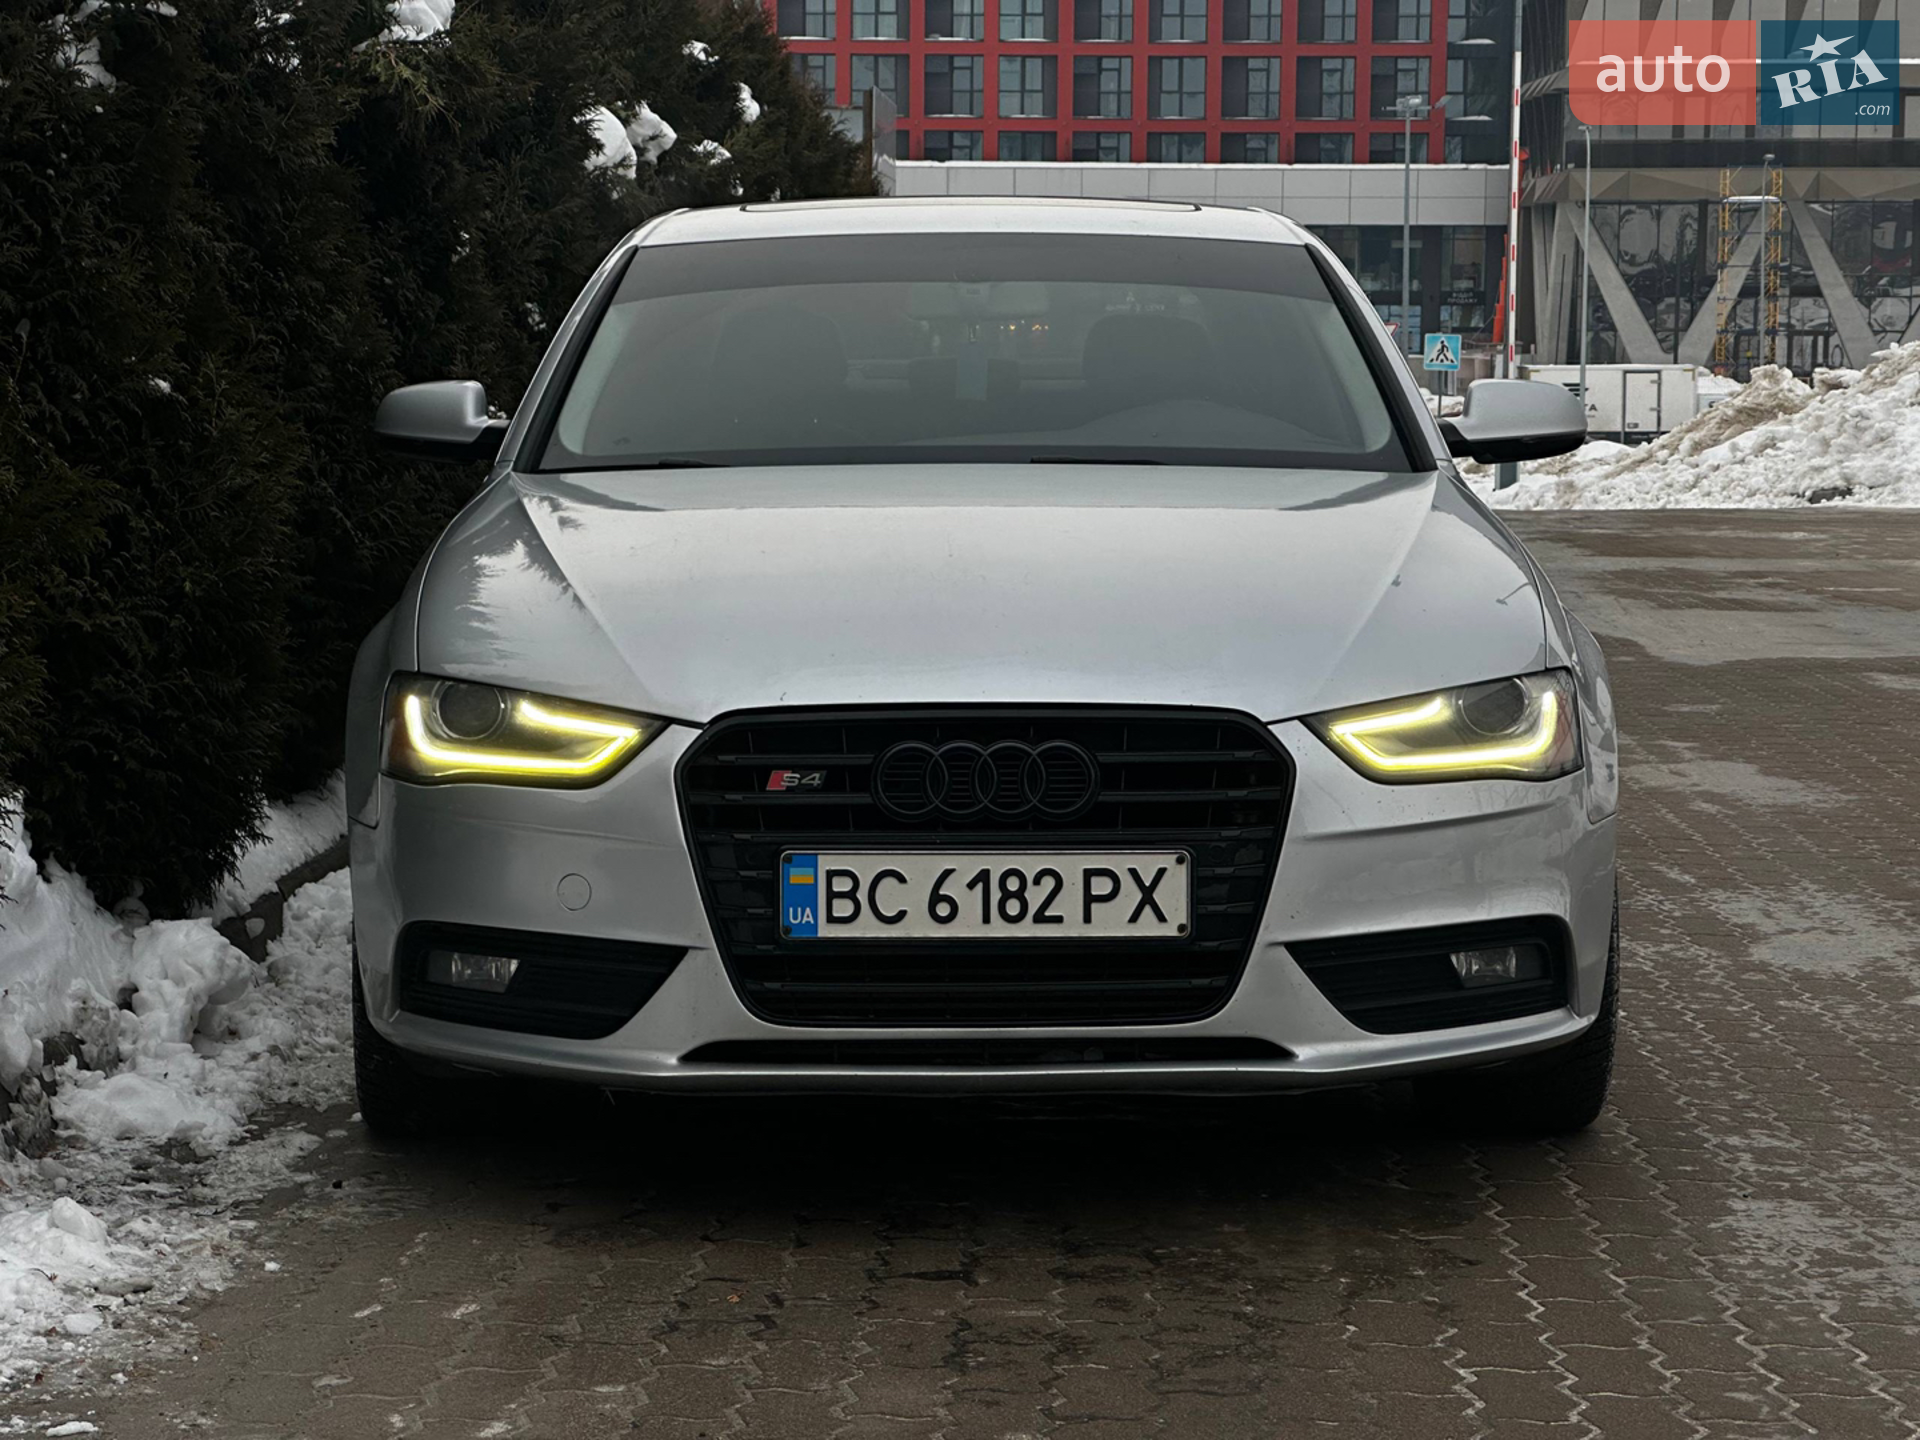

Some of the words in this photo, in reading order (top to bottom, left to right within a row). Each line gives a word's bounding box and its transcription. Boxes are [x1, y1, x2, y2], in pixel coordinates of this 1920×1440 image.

[780, 773, 821, 787] S4
[826, 868, 908, 925] BC
[927, 867, 1065, 925] 6182
[1083, 866, 1169, 925] PX
[789, 907, 814, 924] UA
